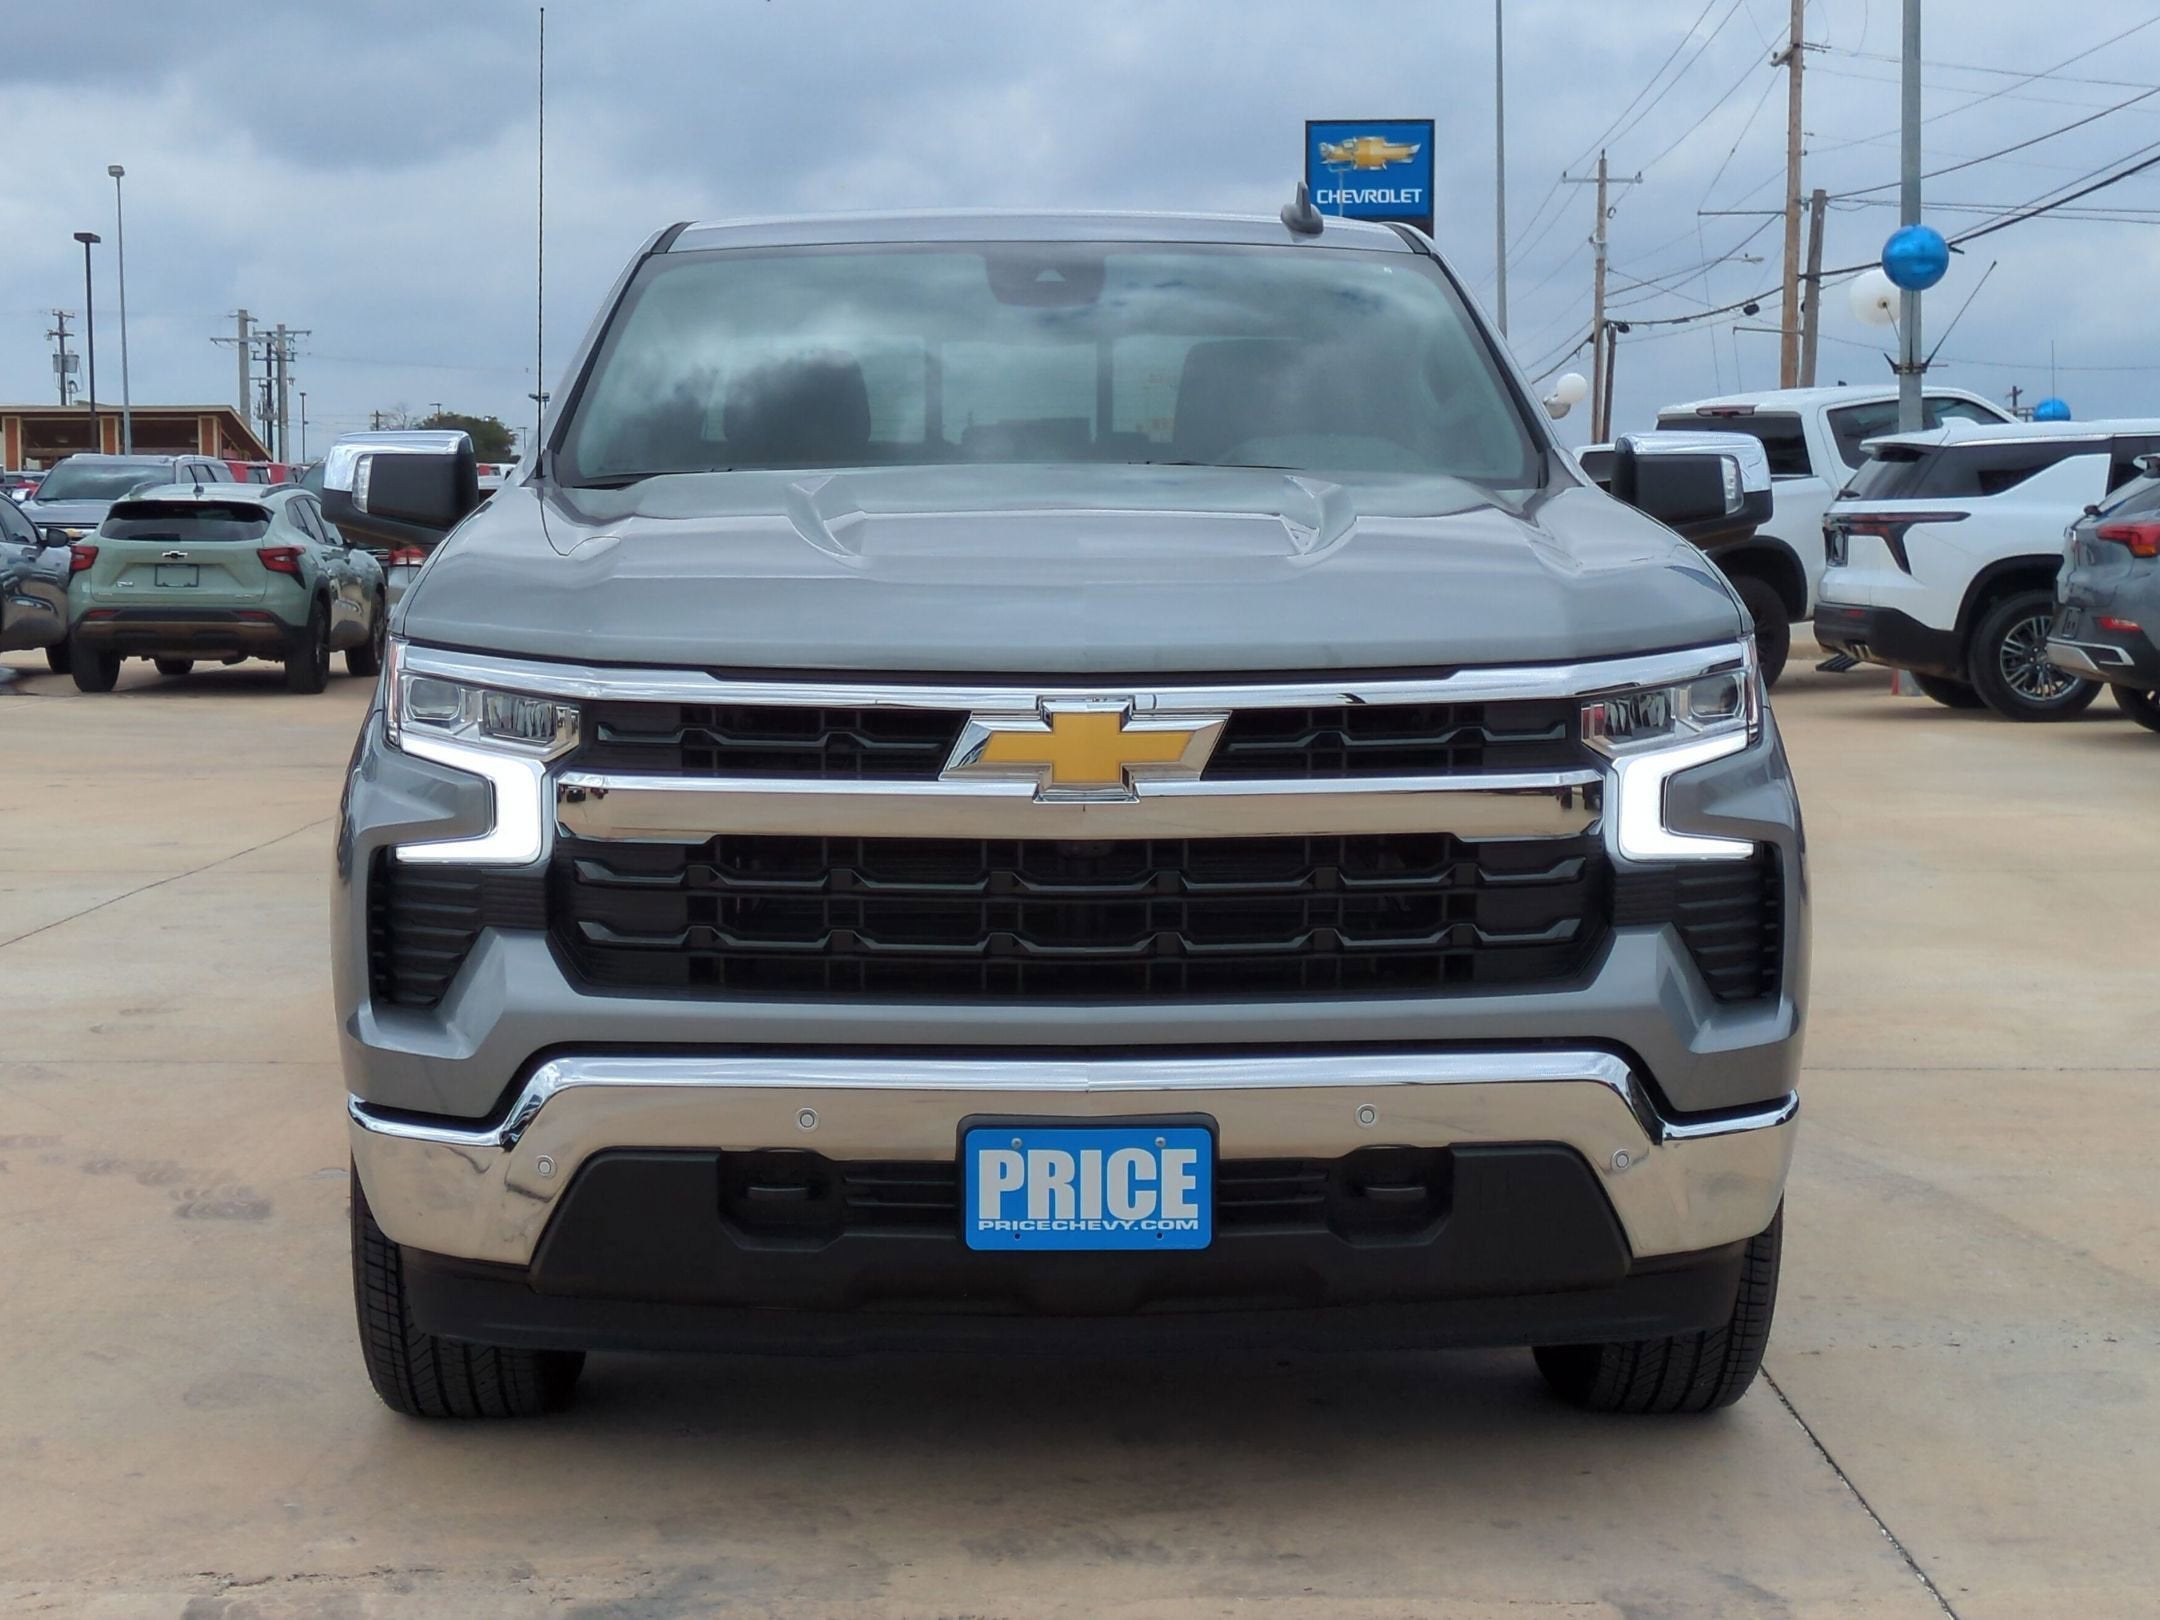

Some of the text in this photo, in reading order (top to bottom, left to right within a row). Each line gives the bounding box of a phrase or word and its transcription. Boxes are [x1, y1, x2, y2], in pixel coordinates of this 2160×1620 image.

[1317, 189, 1423, 204] CHEVROLET
[979, 1148, 1199, 1220] PRICE
[978, 1220, 1199, 1231] PRICECHEVY.COM
